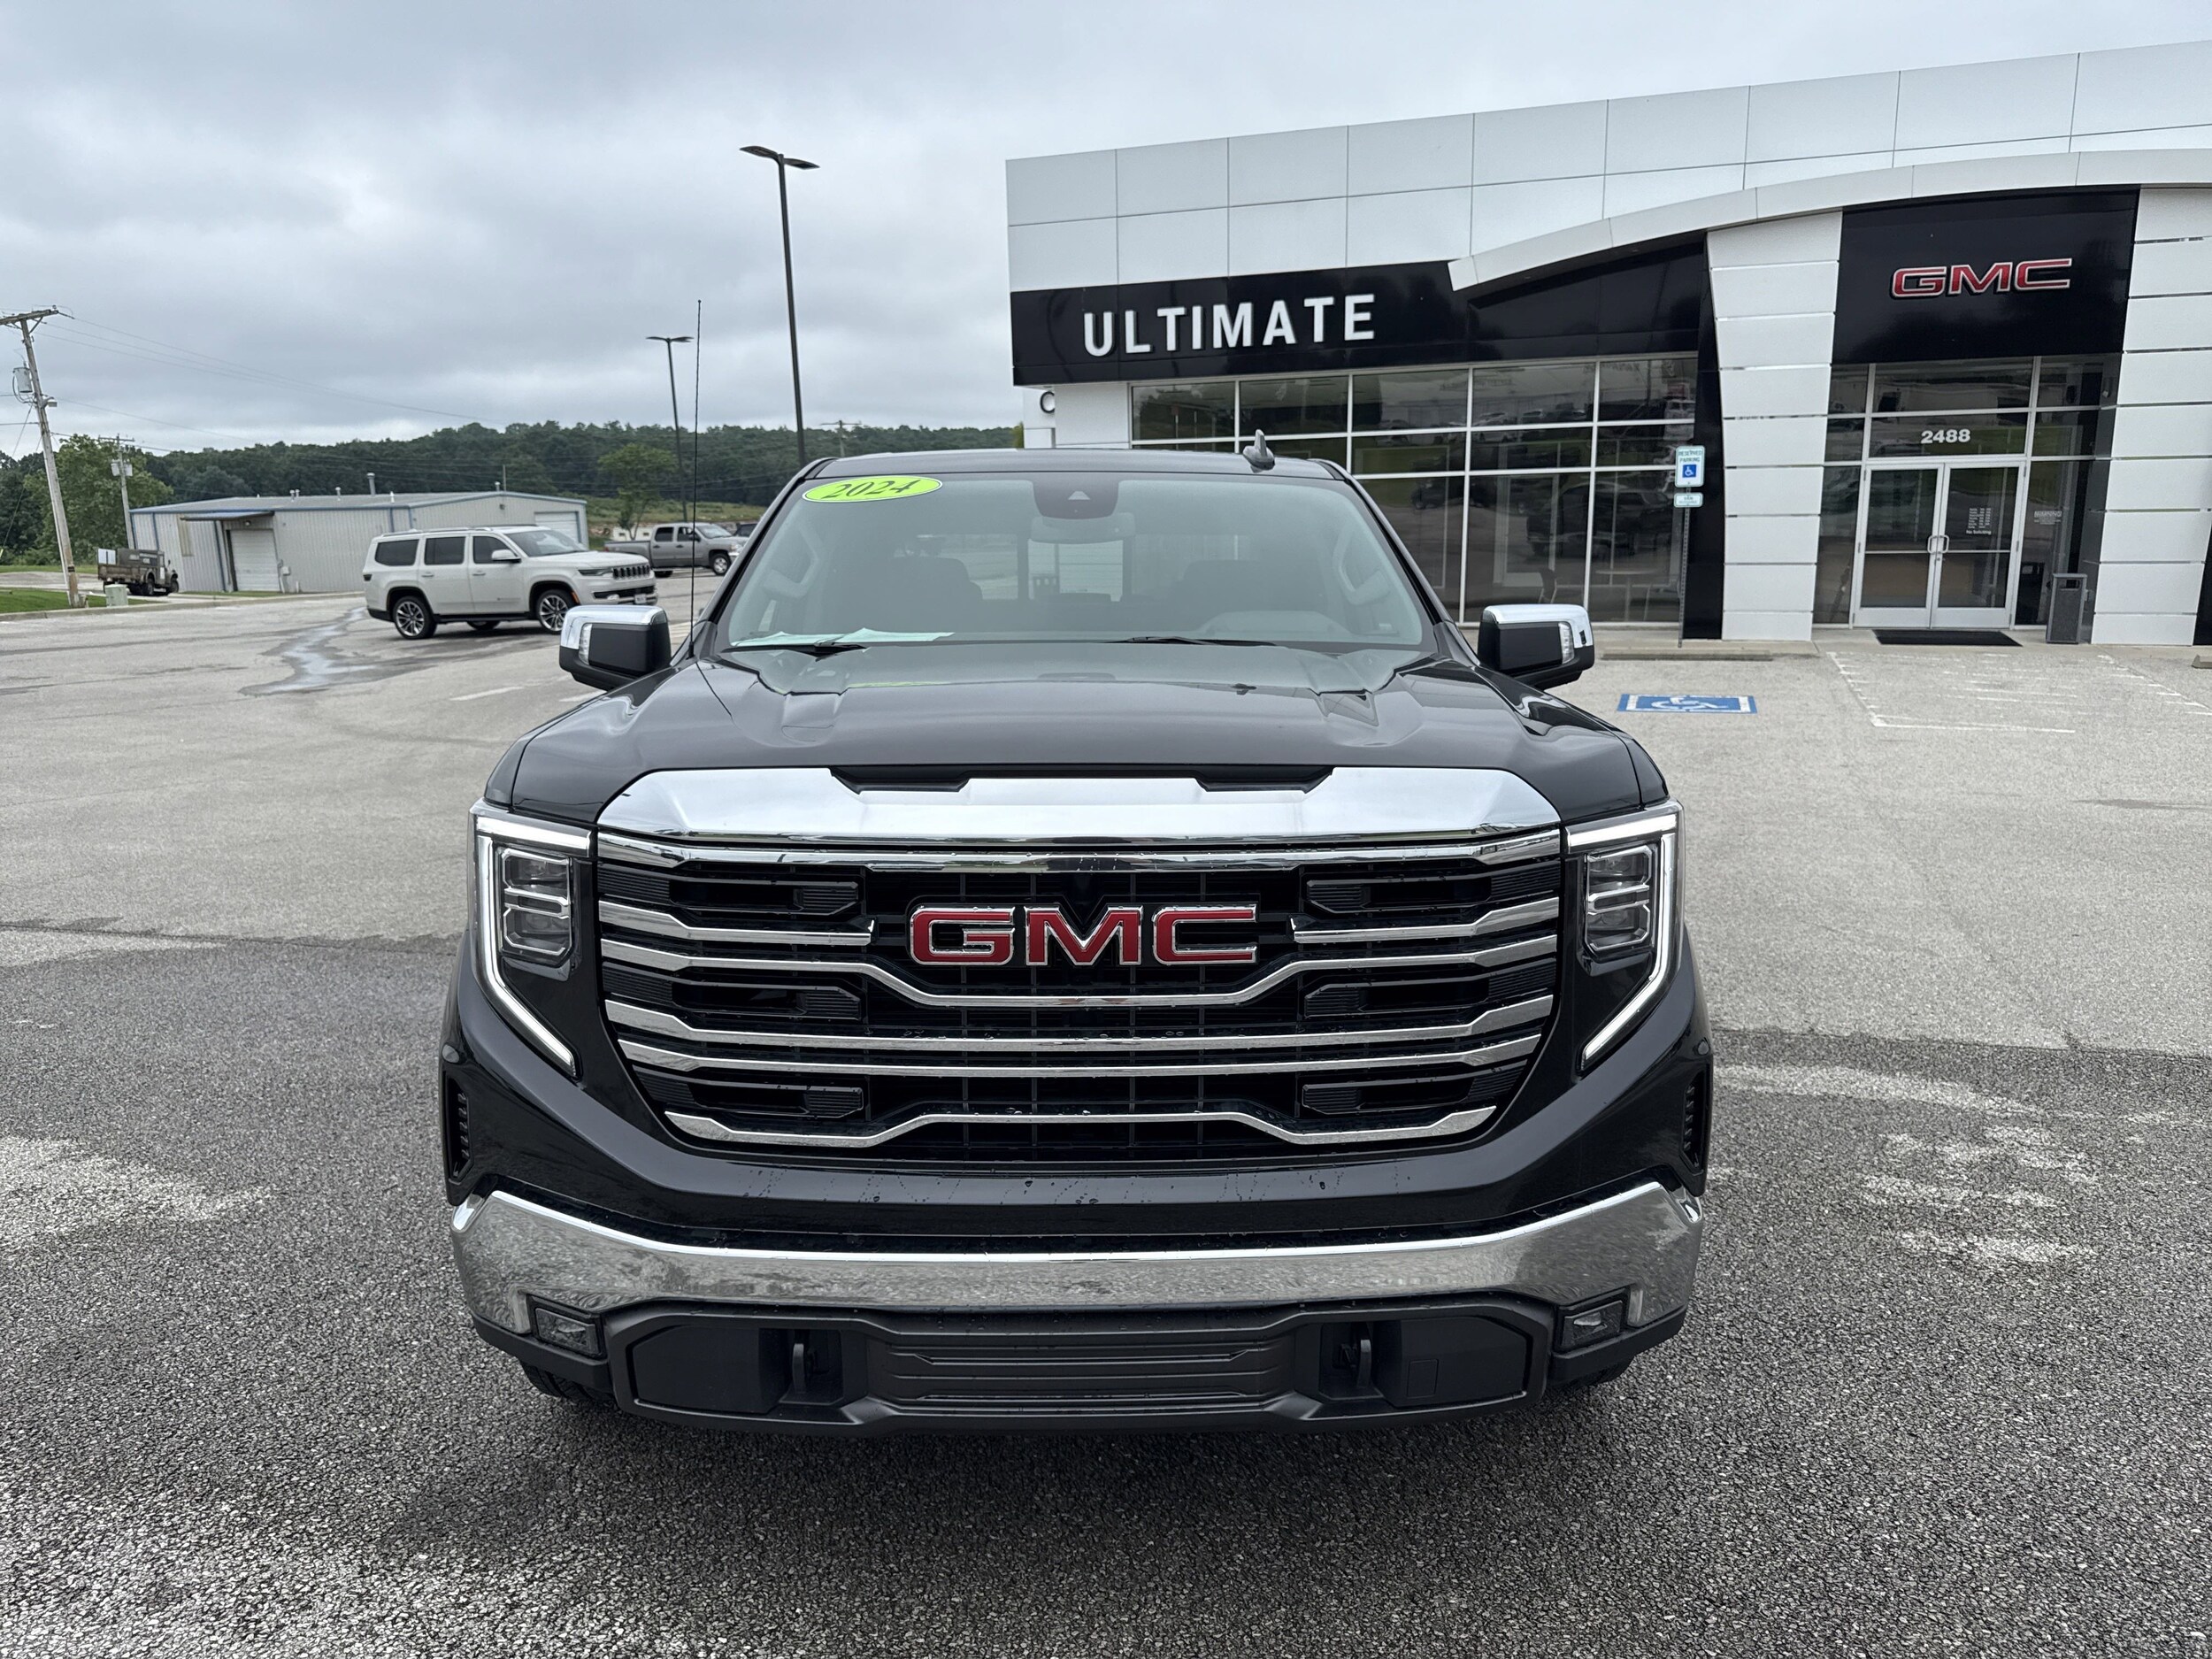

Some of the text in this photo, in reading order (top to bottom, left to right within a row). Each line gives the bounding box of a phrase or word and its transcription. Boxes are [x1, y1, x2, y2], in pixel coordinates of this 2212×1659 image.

[1892, 257, 2072, 297] GMC
[1083, 293, 1375, 357] ULTIMATE
[1920, 428, 1971, 444] 2488
[821, 479, 921, 500] 2024
[910, 902, 1258, 966] GMC
